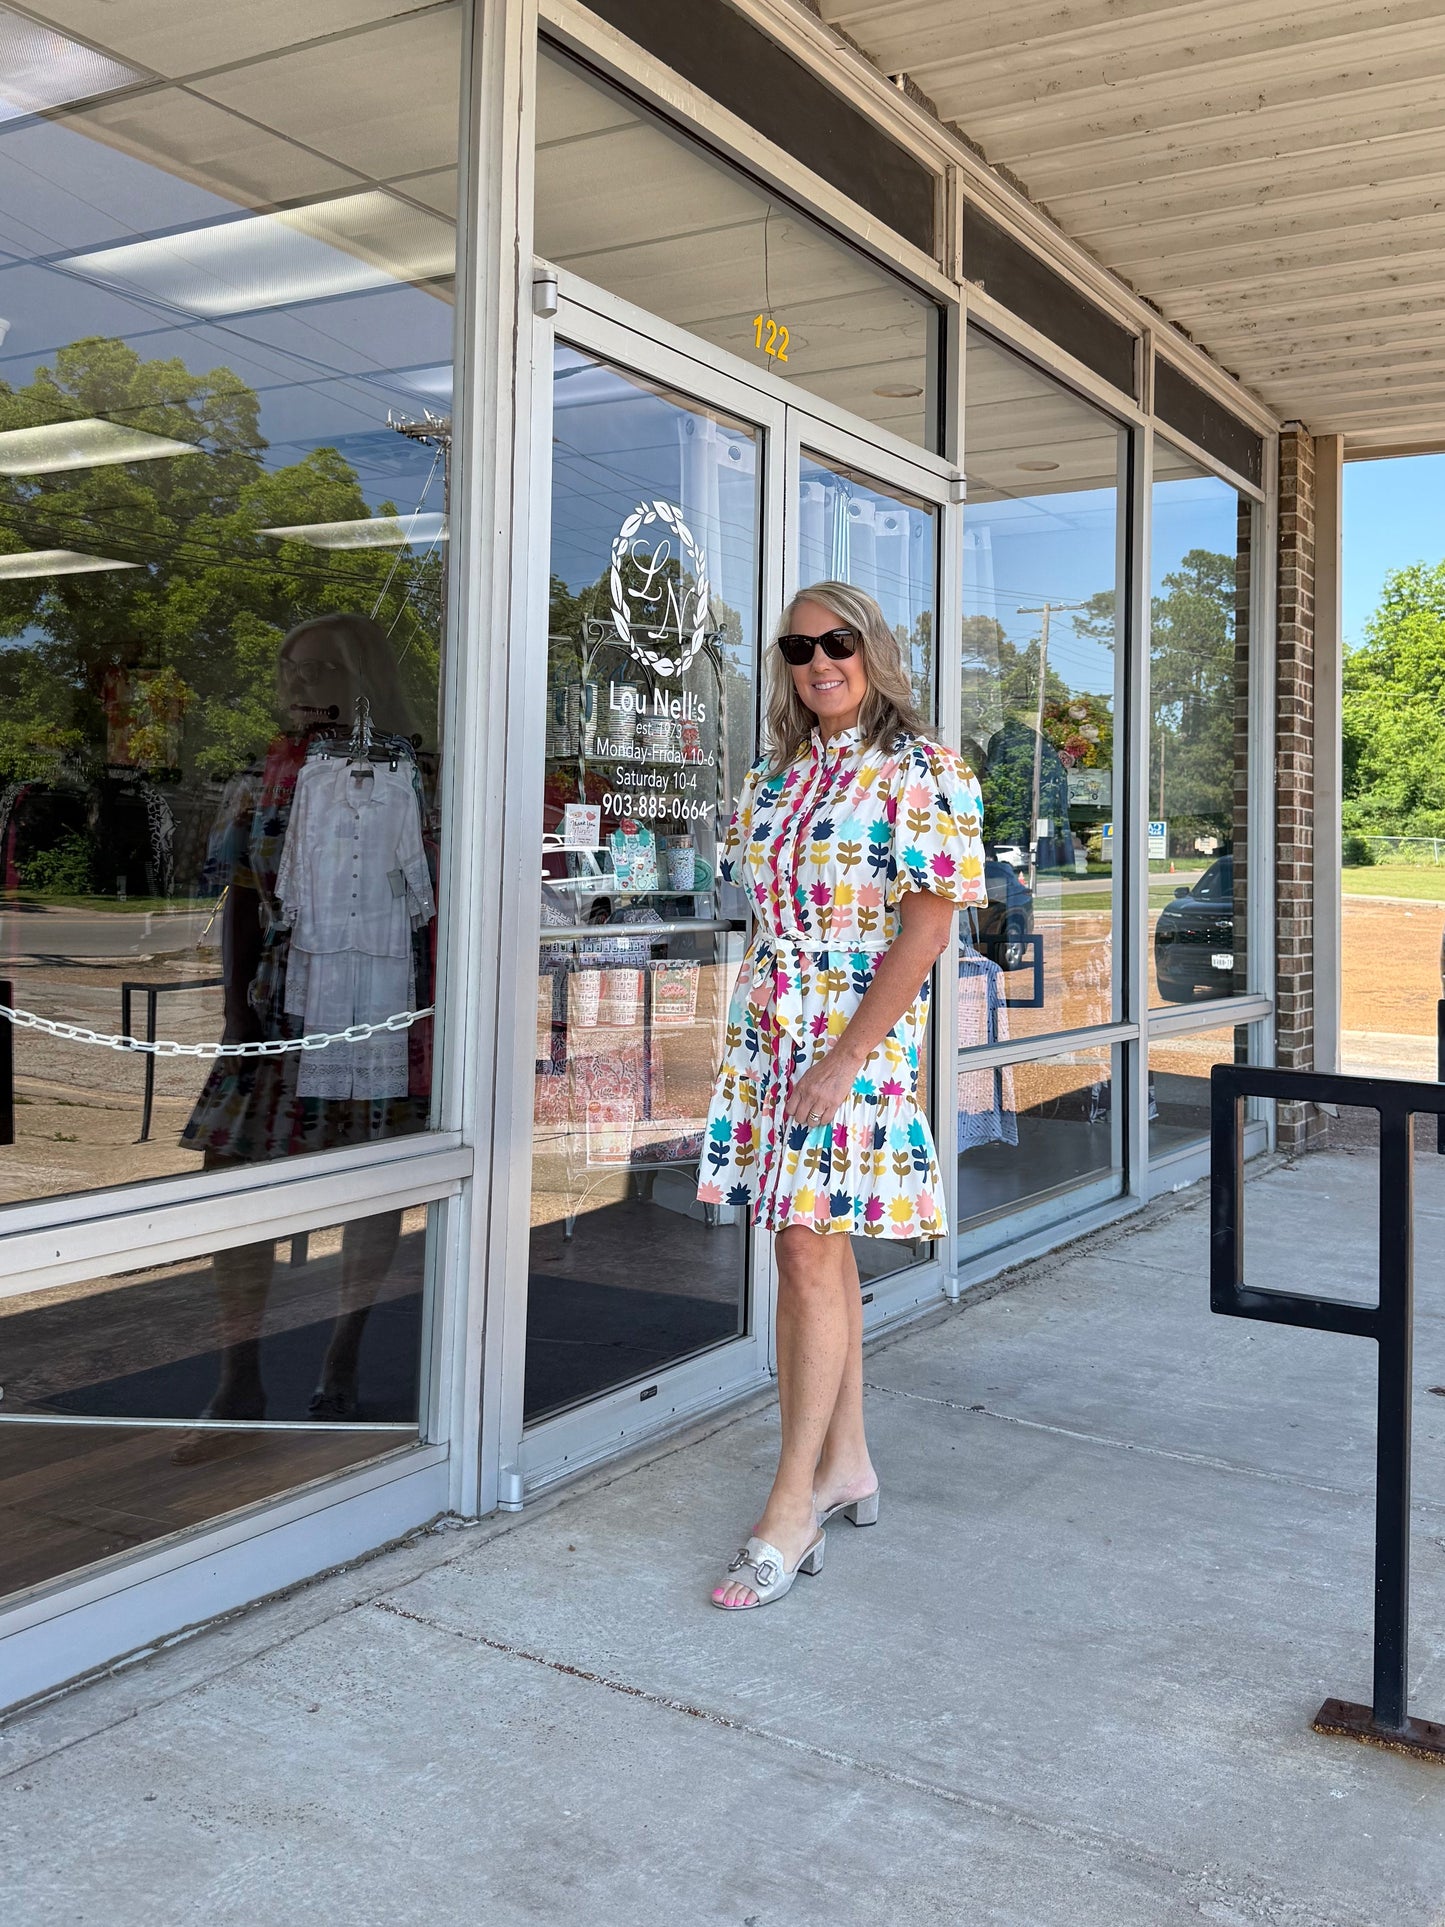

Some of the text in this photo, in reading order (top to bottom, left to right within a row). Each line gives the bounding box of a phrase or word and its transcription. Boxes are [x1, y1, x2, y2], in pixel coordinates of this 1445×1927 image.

[753, 314, 790, 362] 122
[609, 680, 706, 723] Lou Nell's
[636, 721, 682, 739] est. 1973
[596, 737, 715, 769] Monday-Friday 10-6
[616, 766, 697, 793] Saturday 10-4
[602, 792, 708, 820] 903-885-0664
